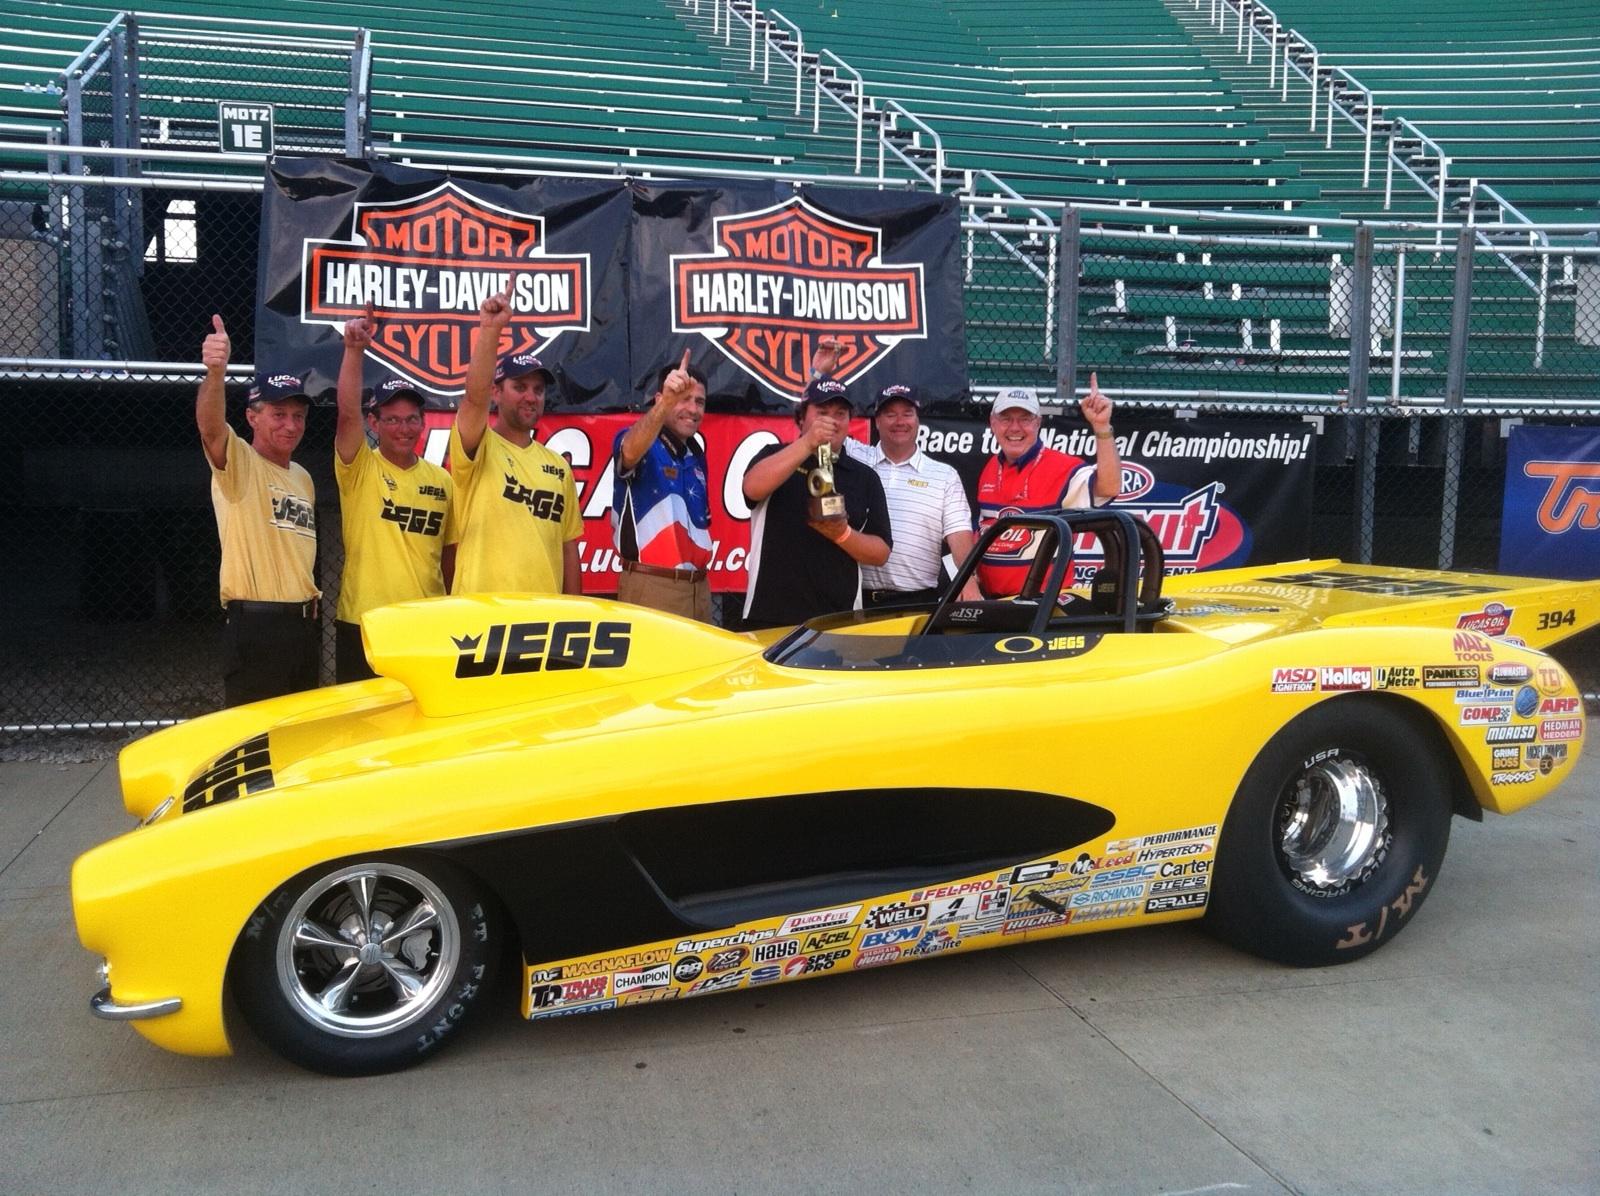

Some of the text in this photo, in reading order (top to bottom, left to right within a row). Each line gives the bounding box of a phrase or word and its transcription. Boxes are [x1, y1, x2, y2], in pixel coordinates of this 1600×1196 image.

[224, 107, 269, 121] MOTZ
[231, 124, 263, 149] 1E
[386, 207, 512, 257] MOTOR
[746, 220, 852, 268] MOTOR
[692, 273, 906, 322] HARLEY-DAVIDSON
[916, 424, 974, 453] Race
[1039, 428, 1138, 457] Natioal
[1141, 431, 1311, 465] Championship!
[380, 504, 444, 536] JEGS
[1537, 609, 1576, 631] 394
[455, 621, 632, 678] JEGS
[1048, 636, 1085, 650] JEGS
[1455, 653, 1494, 661] TOOLS
[1275, 668, 1317, 682] MSD
[1321, 667, 1371, 689] Holley
[1388, 667, 1415, 676] Auto
[1425, 669, 1478, 679] PAINLESS
[1274, 684, 1312, 692] IGNITION
[1387, 677, 1419, 687] Meter
[1463, 707, 1502, 720] COMP
[1540, 698, 1579, 713] ARP
[1487, 726, 1535, 740] MOROSO
[1544, 721, 1580, 730] HEDMAN
[1304, 748, 1340, 769] USA
[1494, 749, 1519, 757] GRIME
[1494, 758, 1519, 768] BOSS
[1142, 825, 1217, 847] PERFORMANCE
[1137, 843, 1204, 862] HYPERTECH
[1094, 863, 1160, 884] SSBC
[1160, 860, 1214, 877] Carter
[924, 879, 994, 900] FEL-PRO
[1091, 885, 1144, 903] RICHMOND
[1148, 894, 1206, 909] DERALE
[880, 906, 926, 924] WELD
[1007, 913, 1067, 930] HUGHES
[675, 929, 775, 954] Superchips
[862, 926, 922, 948] B&M
[562, 949, 672, 978] MAGNAFLOW
[807, 949, 852, 963] SPEED
[804, 960, 835, 974] PRO
[615, 971, 669, 989] CHAMPION
